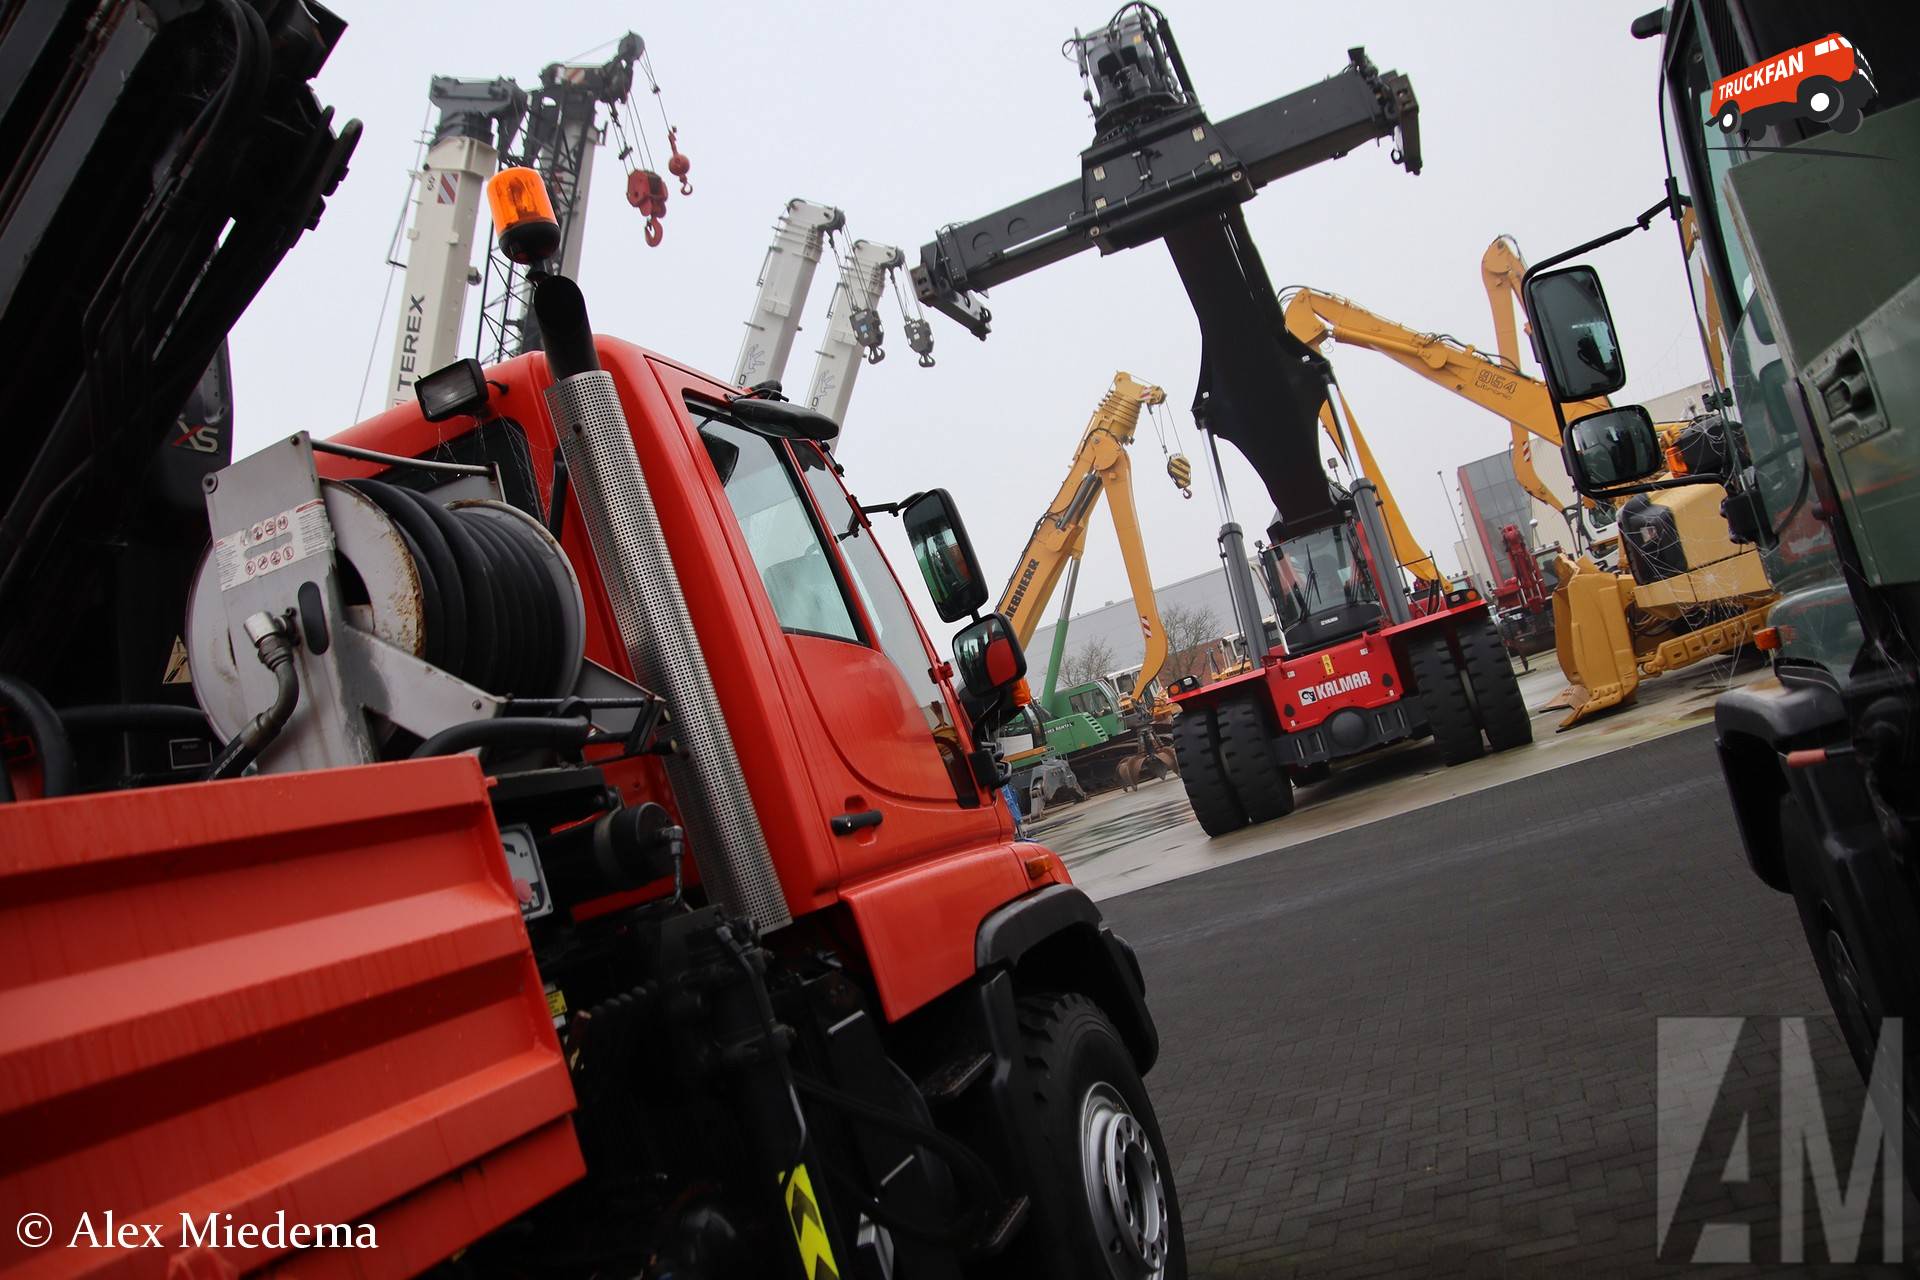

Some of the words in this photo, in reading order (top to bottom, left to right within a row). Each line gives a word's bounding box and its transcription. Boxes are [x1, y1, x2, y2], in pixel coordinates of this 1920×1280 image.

[397, 295, 425, 392] TEREX
[1004, 558, 1040, 621] IEBHERR
[1316, 671, 1371, 700] KALMAR
